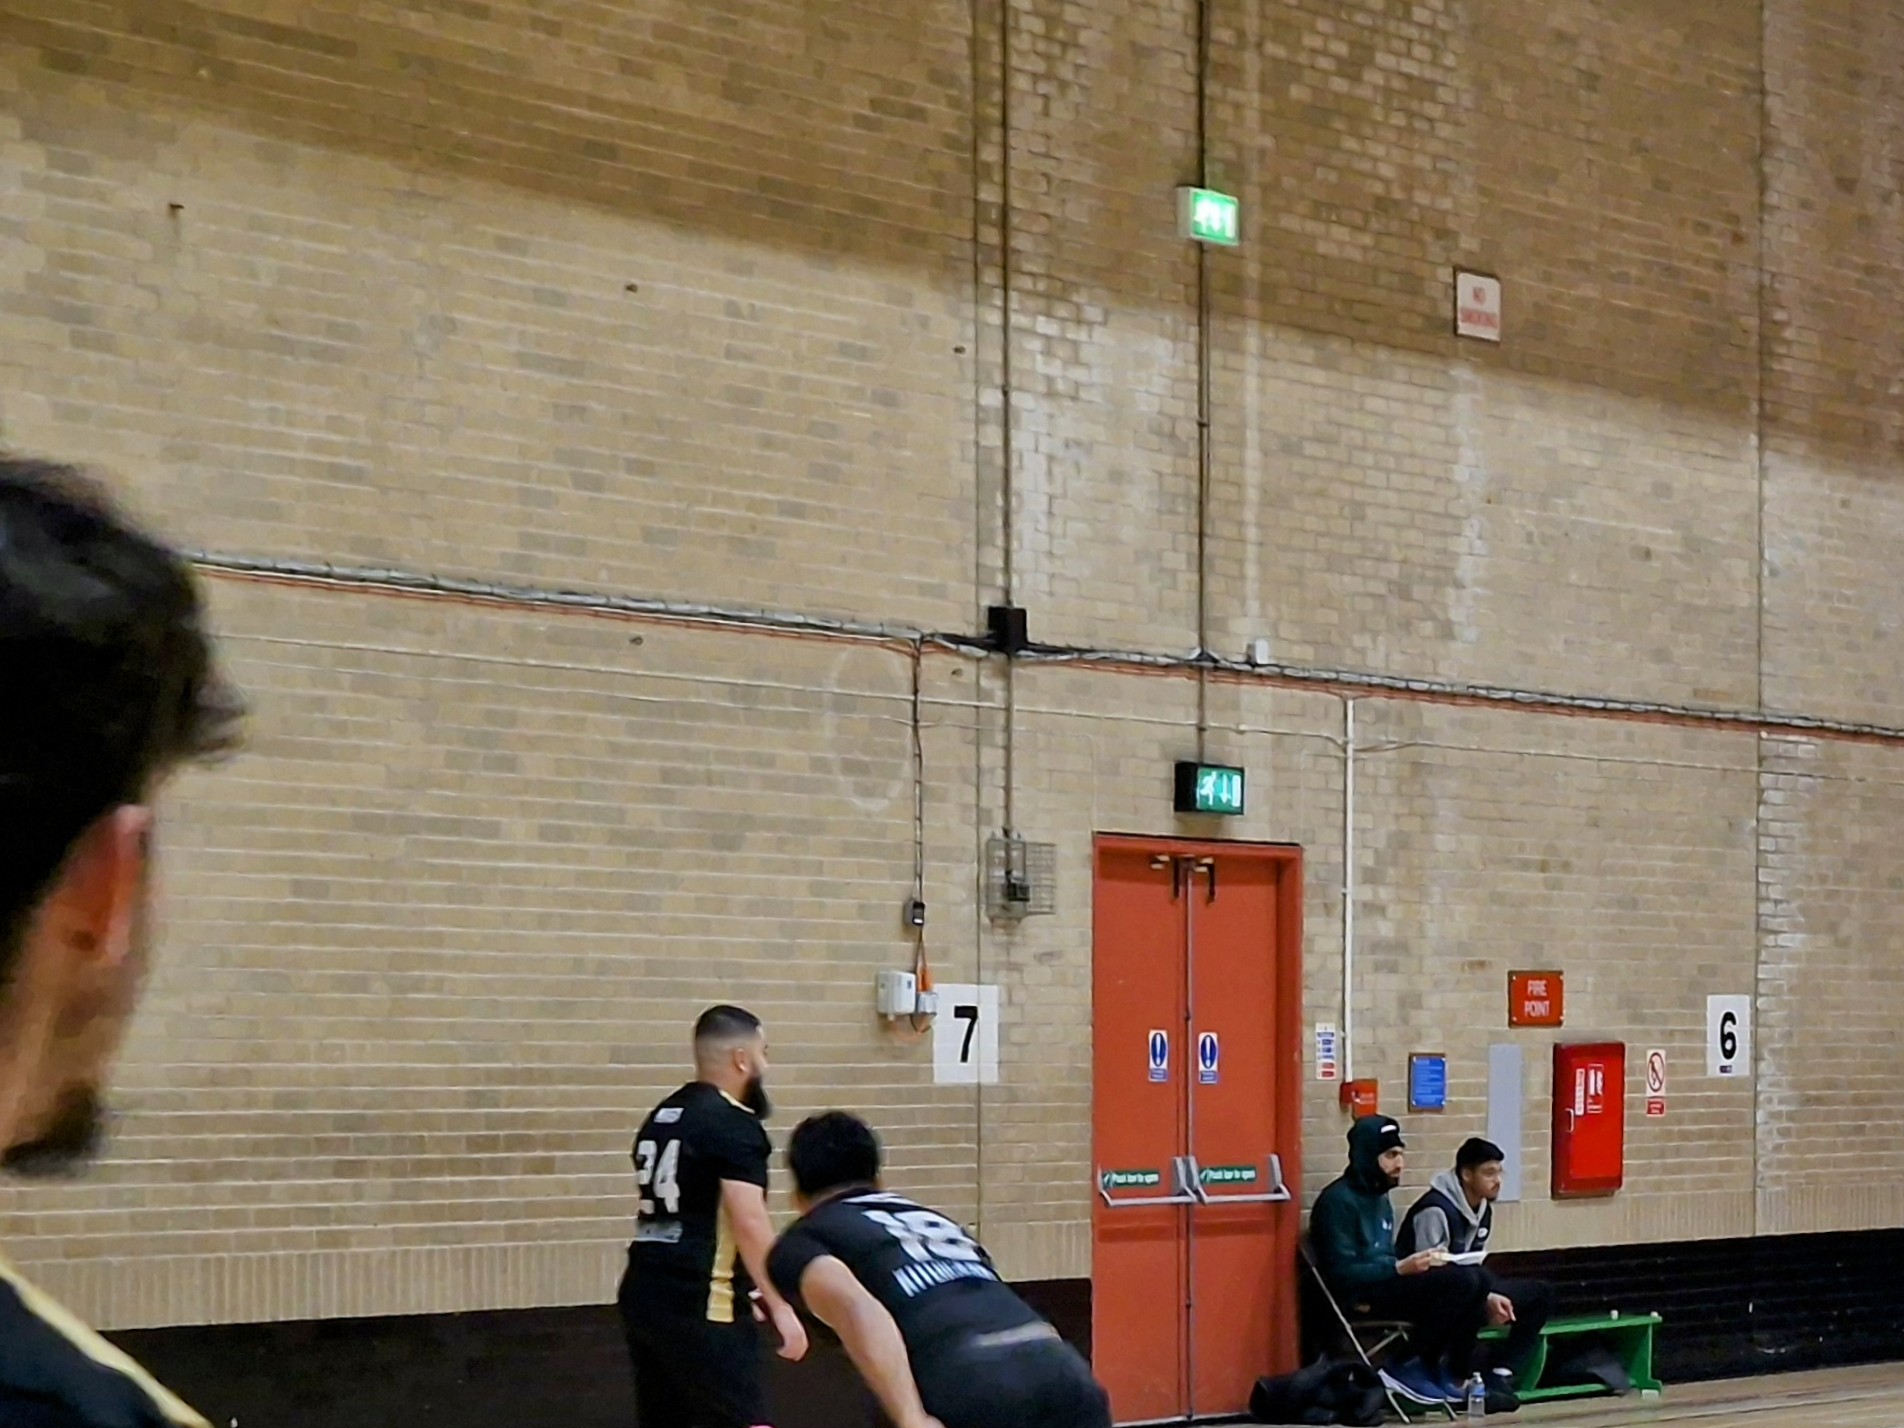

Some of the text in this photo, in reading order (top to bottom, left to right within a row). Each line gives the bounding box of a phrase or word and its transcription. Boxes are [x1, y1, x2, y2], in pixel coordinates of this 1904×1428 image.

[1527, 979, 1548, 996] FIRE
[1524, 1000, 1550, 1017] POINT
[954, 1005, 978, 1063] 7
[1720, 1011, 1737, 1060] 6
